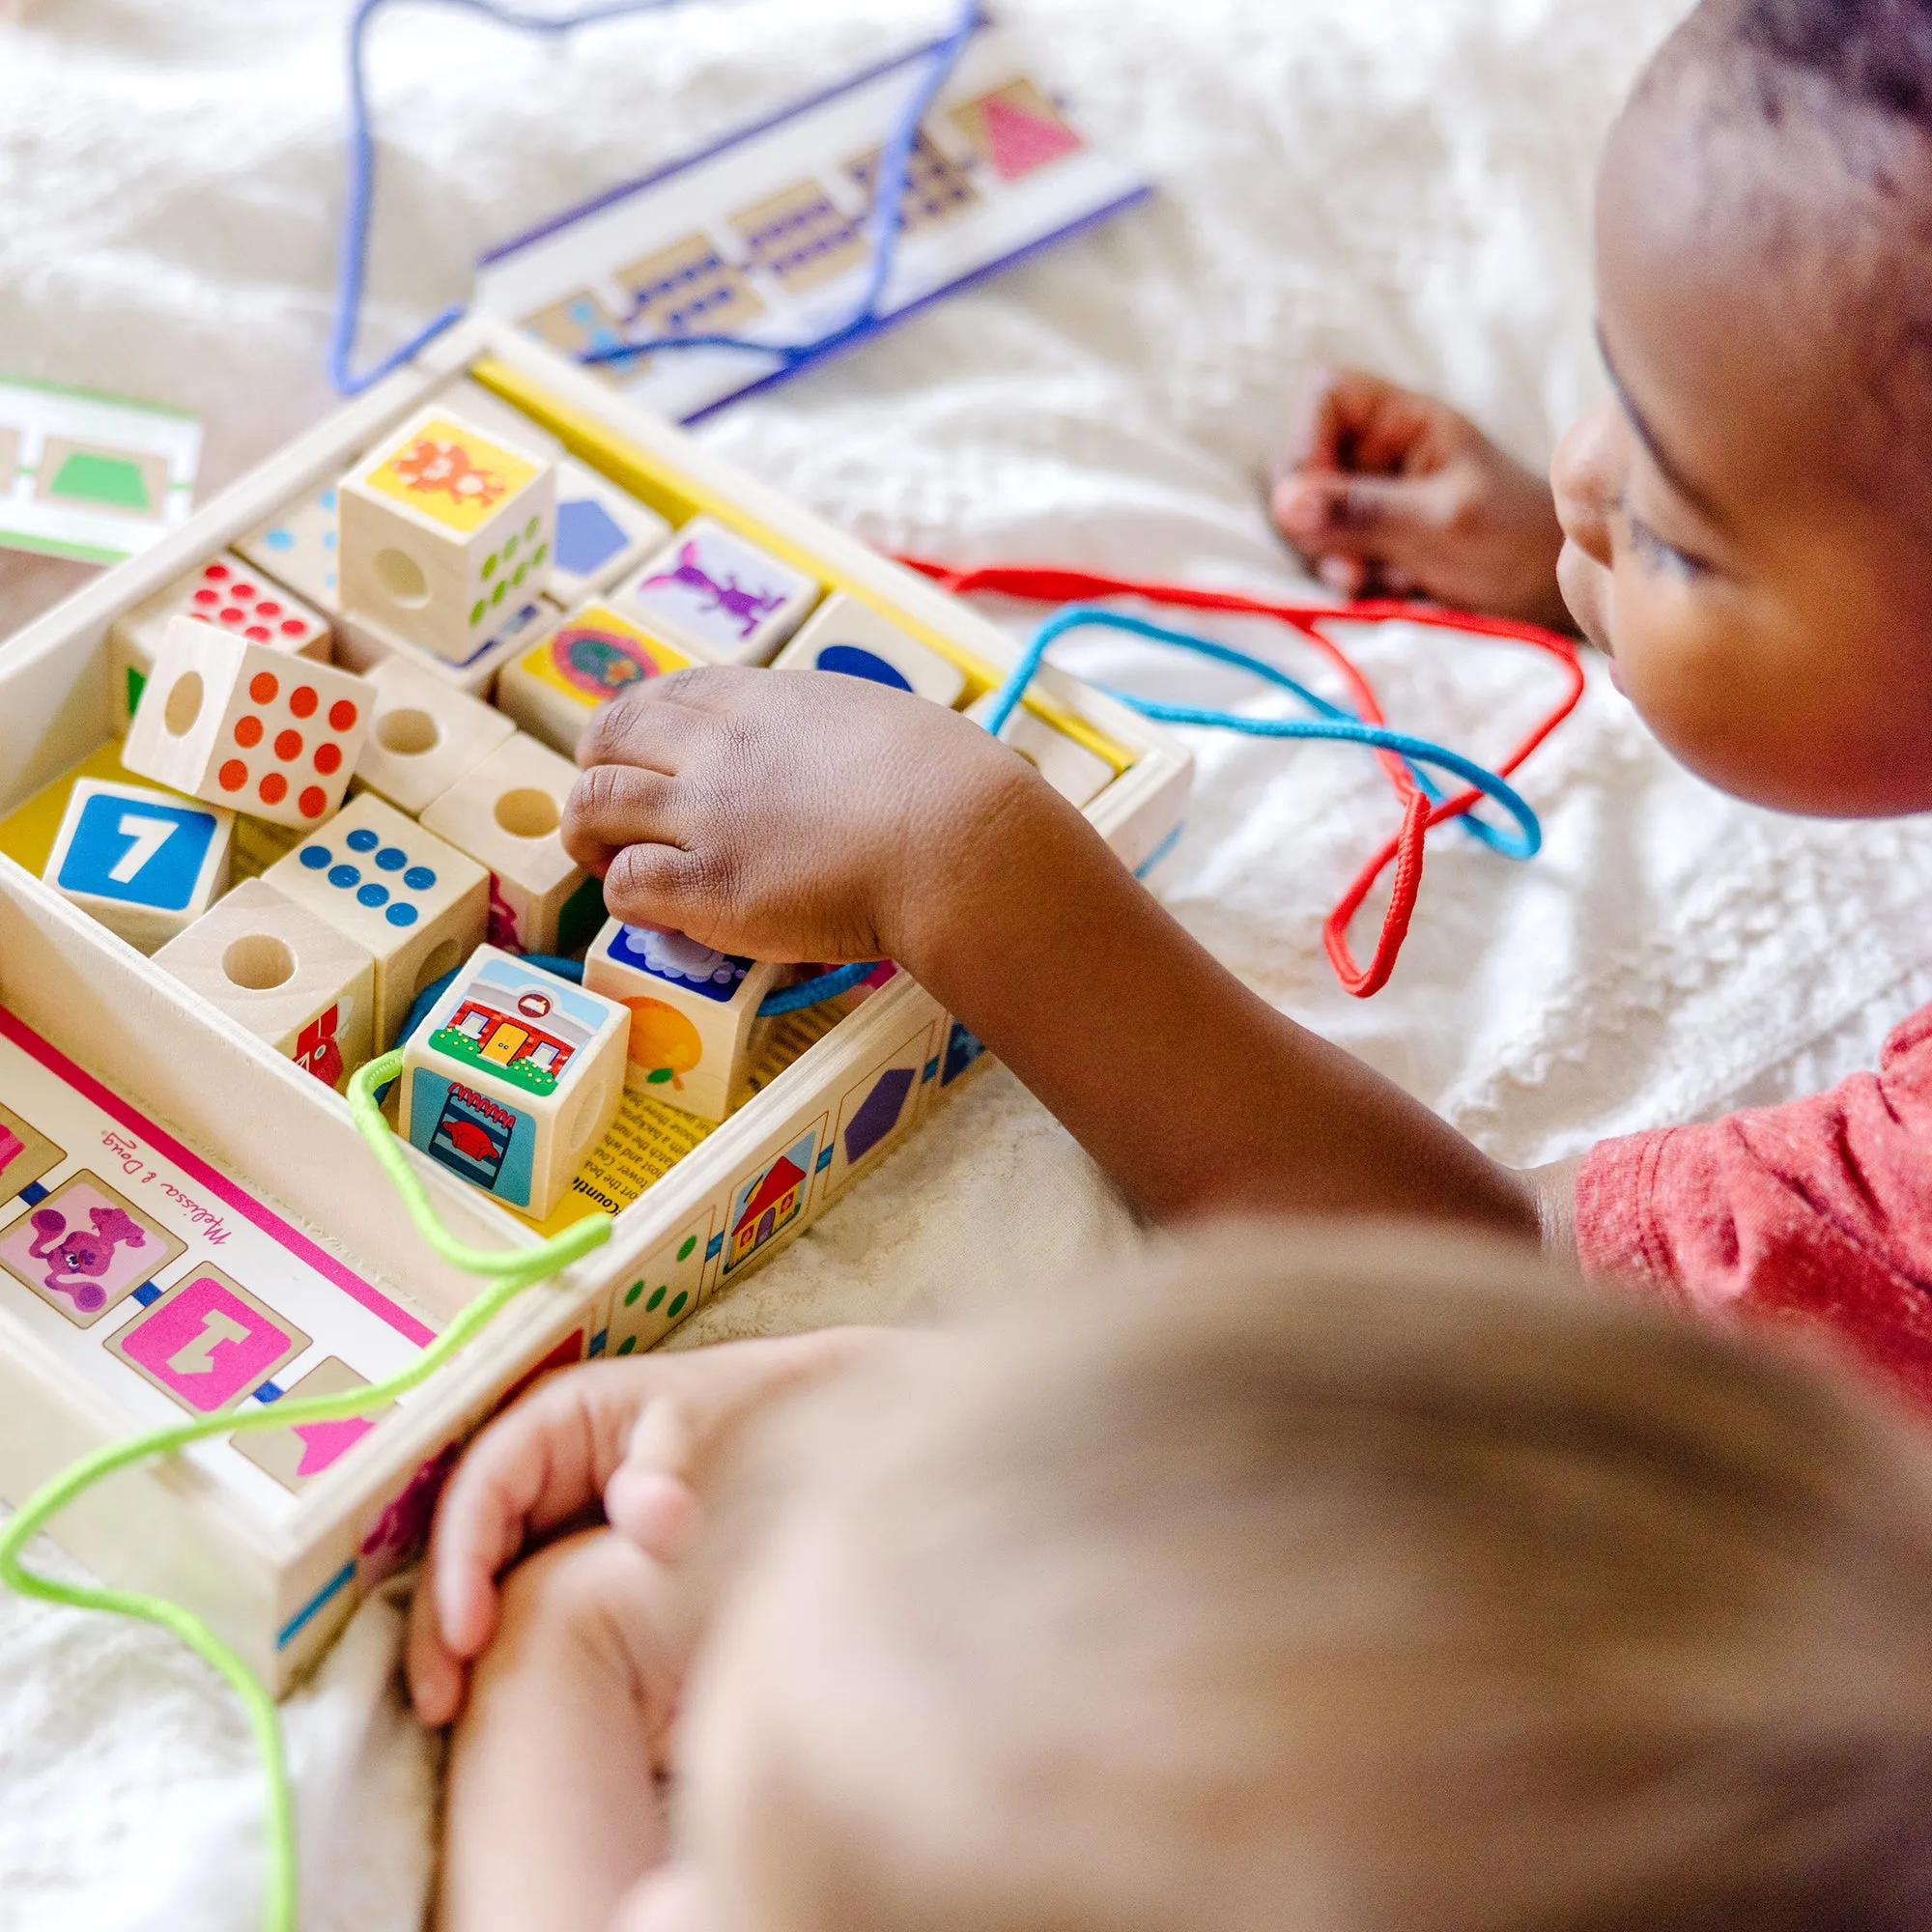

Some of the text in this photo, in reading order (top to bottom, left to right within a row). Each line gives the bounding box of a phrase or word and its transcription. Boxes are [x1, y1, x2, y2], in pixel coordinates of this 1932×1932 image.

[107, 813, 180, 884] 7
[619, 1148, 643, 1163] and
[632, 1135, 651, 1151] the
[101, 1131, 233, 1246] Melissa & Doug
[604, 1175, 622, 1190] the
[165, 1308, 252, 1375] 1
